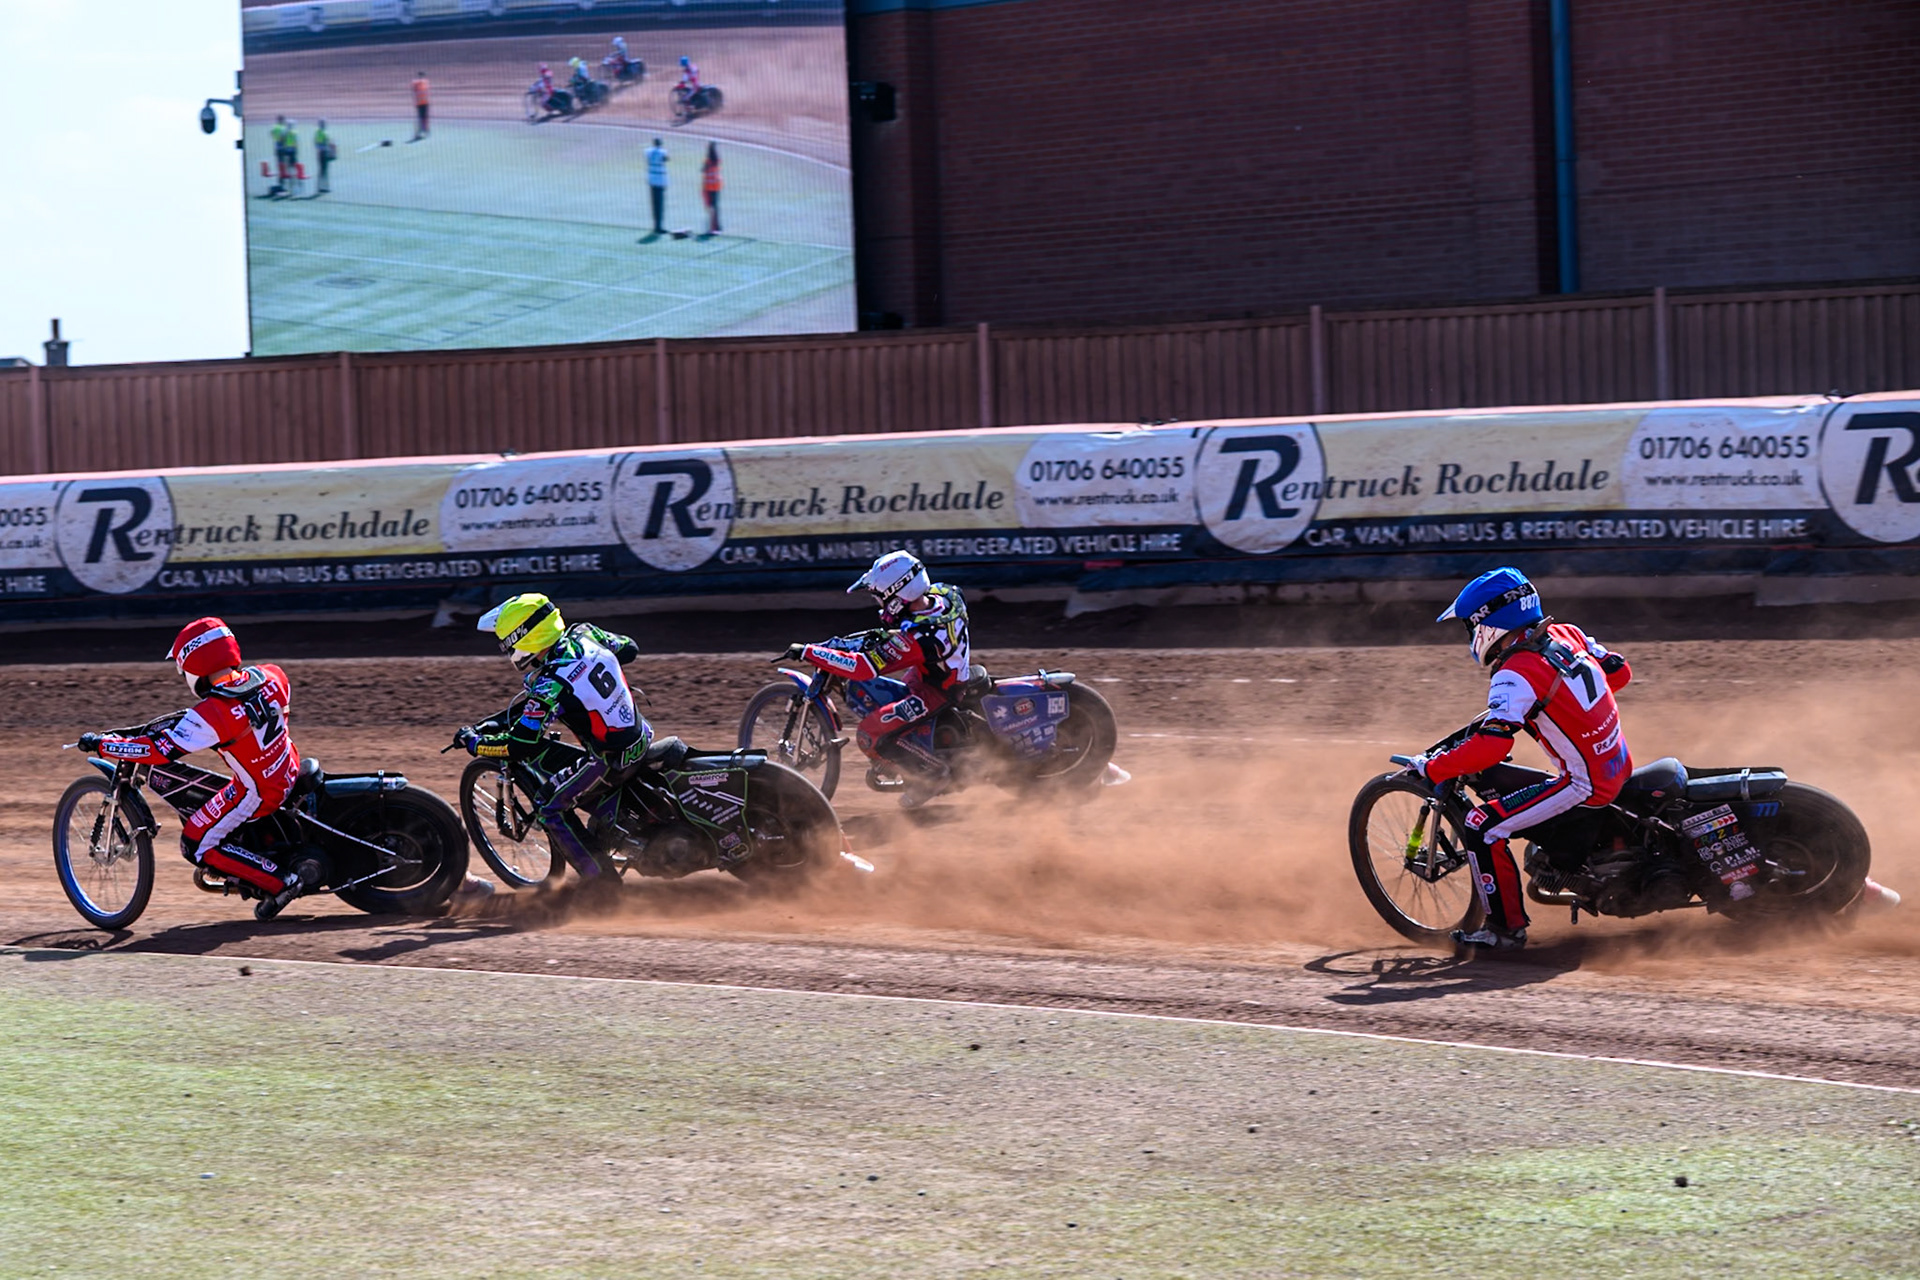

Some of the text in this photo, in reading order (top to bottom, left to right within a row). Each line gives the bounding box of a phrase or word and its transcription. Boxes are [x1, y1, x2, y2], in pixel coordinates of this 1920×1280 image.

[1639, 434, 1810, 459] 01706 640055
[1029, 456, 1186, 482] 01706 640055
[1218, 434, 1610, 521] Rentruck Rochdale
[1644, 469, 1803, 487] www.rentruck.co.uk
[455, 481, 603, 509] 01706 640055
[634, 458, 1004, 540] Rentruck Rochdale
[1033, 487, 1180, 506] www.rentruck.co.uk
[77, 487, 430, 563] Rentruck Rochdale
[459, 511, 599, 532] www.rentruck.co.uk
[1303, 518, 1808, 548] CAR, VAN, MINIBUS & REFRIGERATED VEHICLE HIRE
[818, 539, 900, 560] MINIBUS
[921, 536, 1057, 558] REFRIGERATED
[1059, 534, 1136, 554] VEHICLE
[1140, 532, 1182, 551] HIRE
[252, 565, 333, 584] MINIBUS
[335, 565, 350, 582] &
[352, 560, 482, 581] REFRIGERATED
[484, 555, 557, 576] VEHICLE
[560, 553, 602, 572] HIRE
[812, 648, 856, 669] COLEMAN
[587, 661, 617, 700] 6
[1569, 661, 1598, 704] 7
[262, 703, 285, 747] 2
